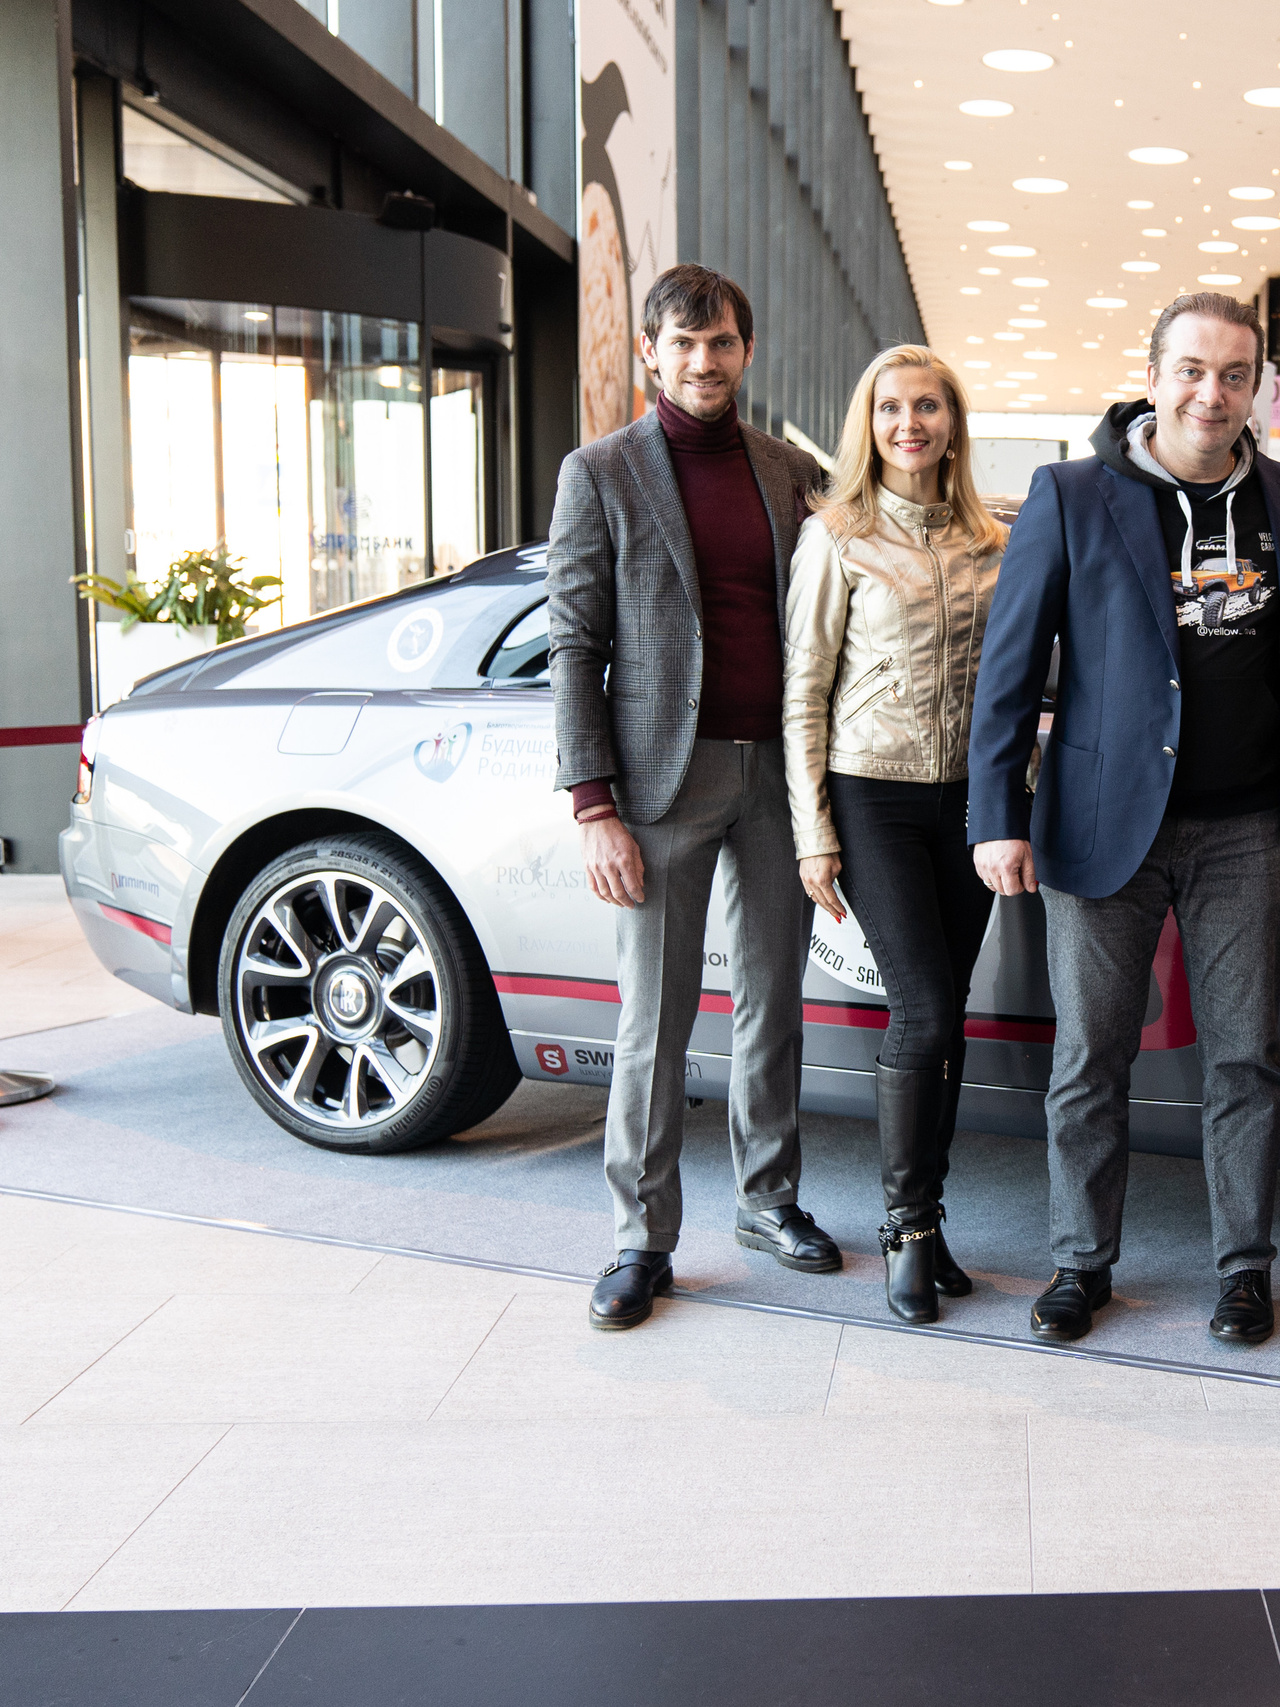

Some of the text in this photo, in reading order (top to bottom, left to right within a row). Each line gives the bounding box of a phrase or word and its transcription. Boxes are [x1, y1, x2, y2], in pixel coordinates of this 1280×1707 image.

[481, 734, 555, 758] Будуще
[329, 849, 369, 865] 285/35
[380, 867, 392, 878] 21
[403, 885, 415, 900] XL
[810, 934, 844, 971] NACO
[389, 1076, 443, 1136] Continental
